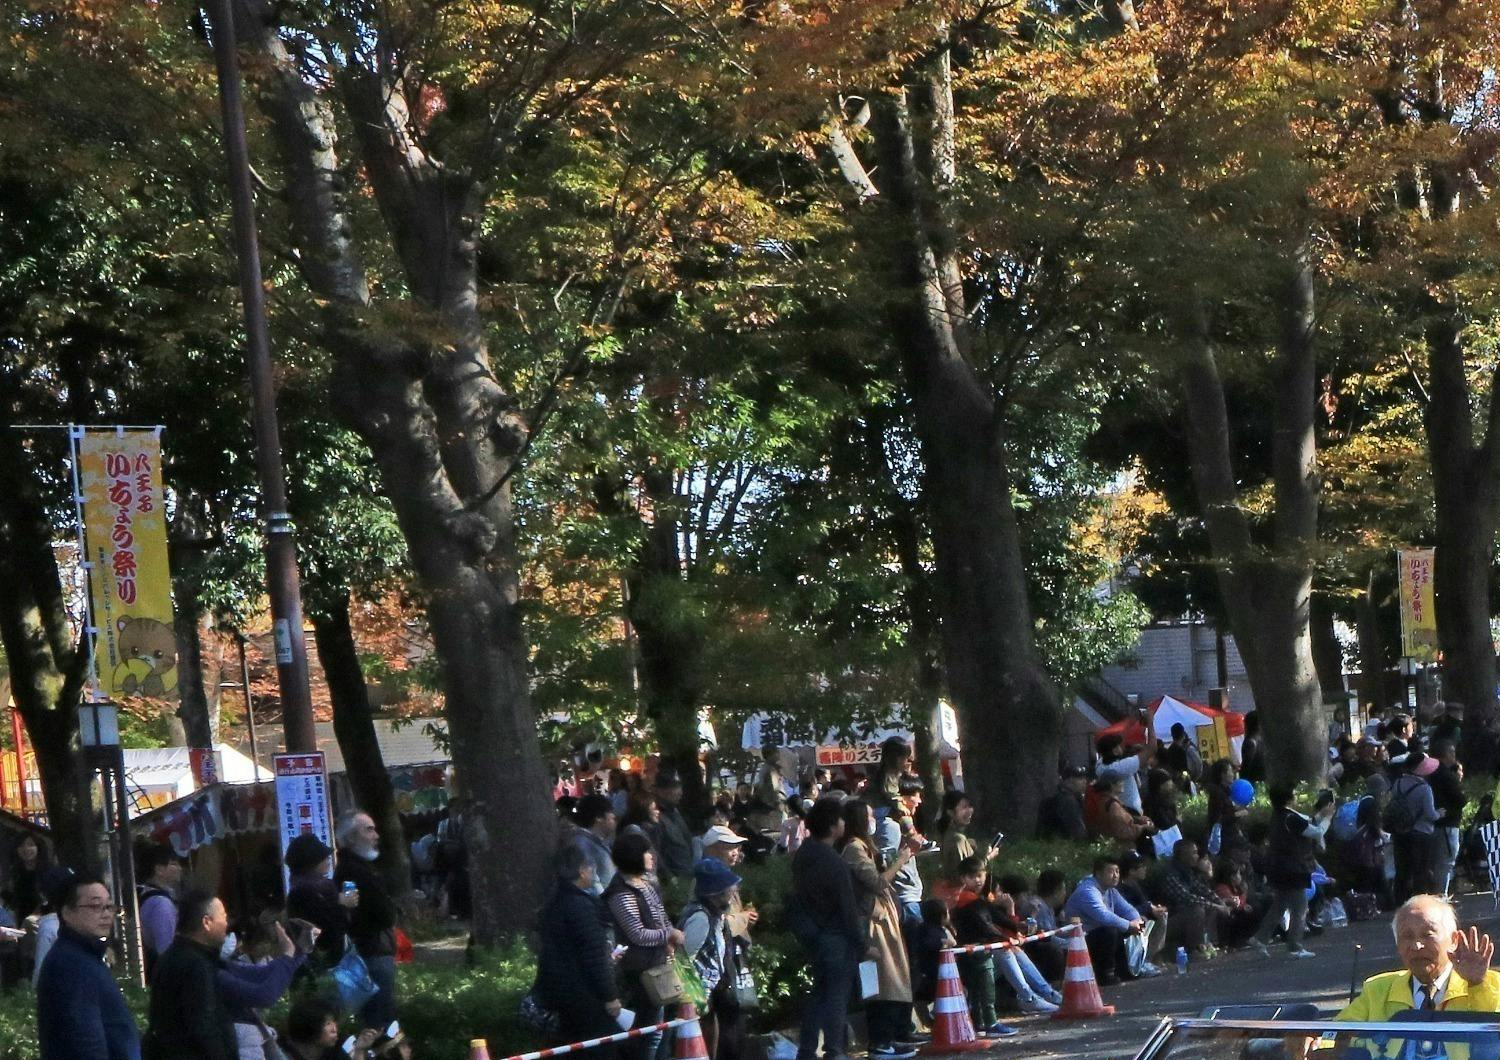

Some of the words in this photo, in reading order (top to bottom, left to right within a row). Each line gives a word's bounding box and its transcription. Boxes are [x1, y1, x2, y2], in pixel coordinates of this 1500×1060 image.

[105, 453, 137, 605] いちょう祭り
[135, 453, 153, 513] 八王子
